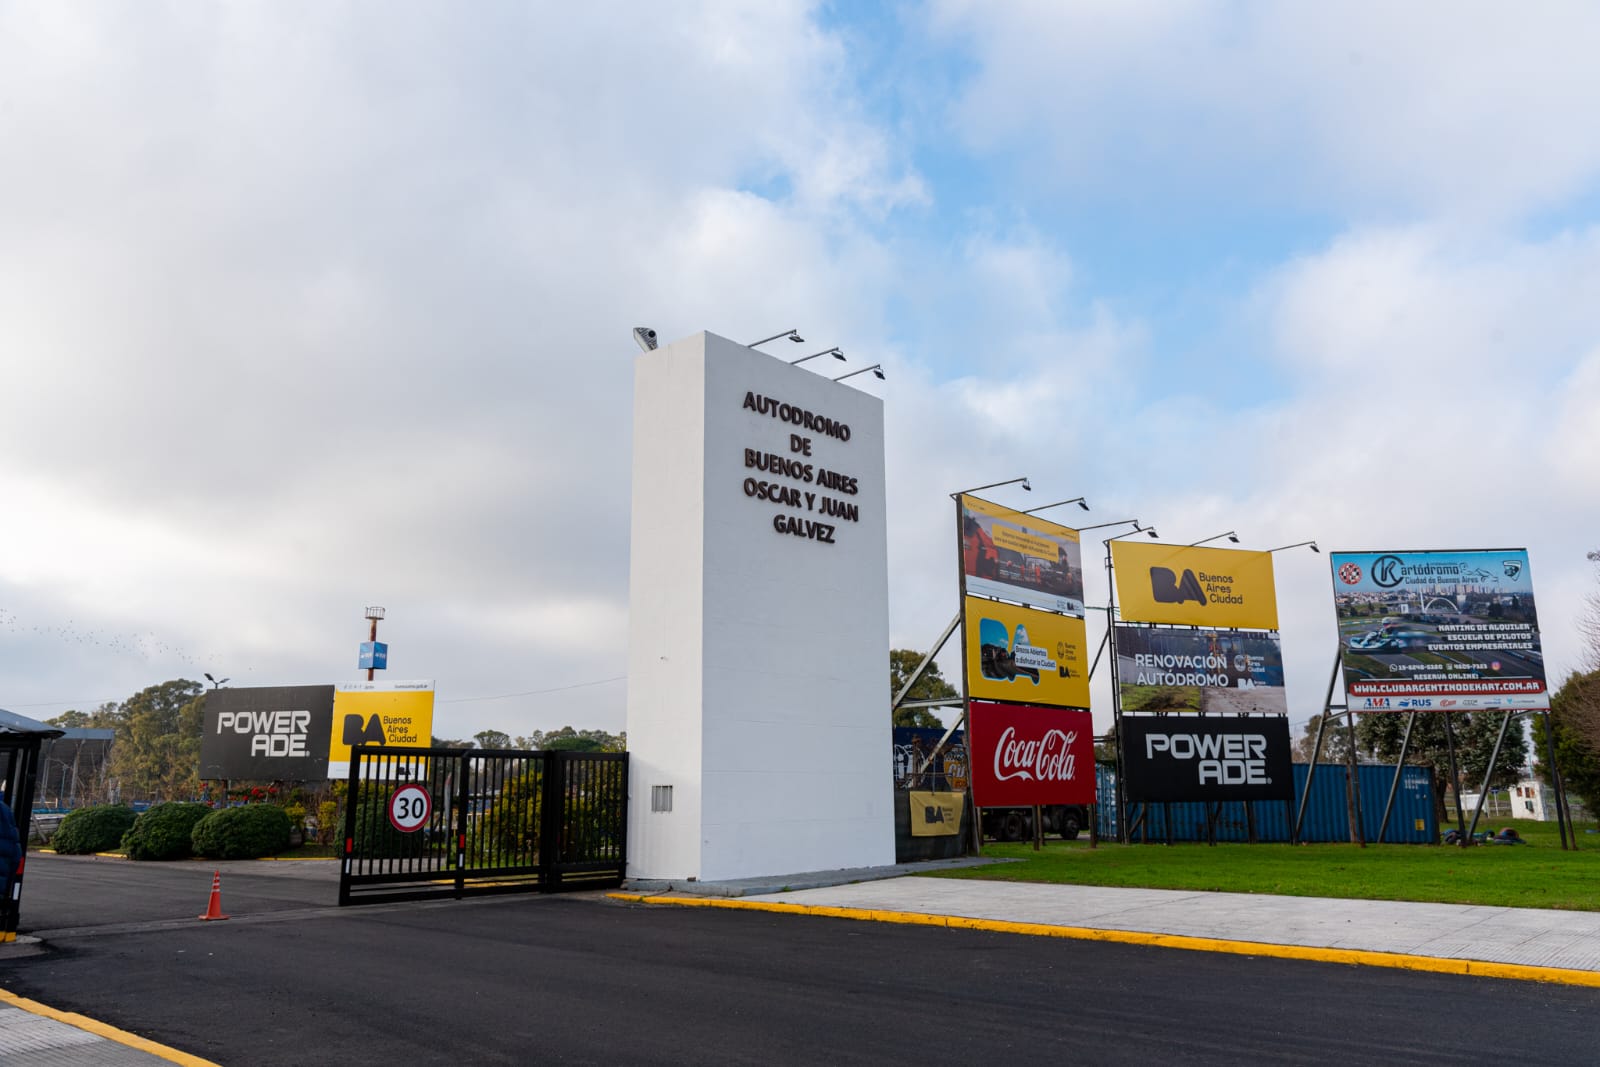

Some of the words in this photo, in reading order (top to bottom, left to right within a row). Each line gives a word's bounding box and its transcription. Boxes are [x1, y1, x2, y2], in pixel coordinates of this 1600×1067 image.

[743, 391, 851, 441] AUTODROMO
[790, 433, 812, 456] DE
[744, 448, 813, 482] BUENOS
[816, 468, 858, 495] AIRES
[743, 477, 802, 508] OSCAR
[804, 492, 816, 511] Y
[819, 496, 859, 522] JUAN
[773, 514, 835, 544] GALVEZ
[1149, 566, 1207, 606] BA
[1199, 572, 1233, 583] Buenos
[1405, 577, 1427, 585] Ciudad
[1437, 576, 1460, 584] Buenos
[1461, 575, 1479, 583] Aires
[1206, 583, 1231, 593] Aires
[1209, 593, 1243, 604] Ciudad
[1438, 624, 1475, 632] KARTING
[1488, 623, 1530, 631] ALQUILER
[1447, 633, 1483, 641] ESCUELA
[1496, 632, 1532, 640] PILOTOS
[1428, 643, 1465, 651] EVENTOS
[1466, 642, 1533, 650] EMPRESARIALES
[1135, 652, 1228, 669] RENOVACIÓN
[1136, 669, 1229, 687] AUTÓDROMO
[1353, 681, 1540, 693] WWW.CLUBARGENTINODEKART.COM.AR
[1365, 697, 1390, 707] AMA
[1411, 699, 1433, 707] RUS
[216, 710, 311, 734] POWER
[383, 715, 412, 725] Buenos
[342, 713, 387, 746] BA
[386, 725, 409, 734] Aires
[388, 733, 417, 743] Ciudad
[993, 726, 1078, 782] Coca-Cola
[1145, 733, 1267, 759] POWER
[396, 797, 424, 820] 30
